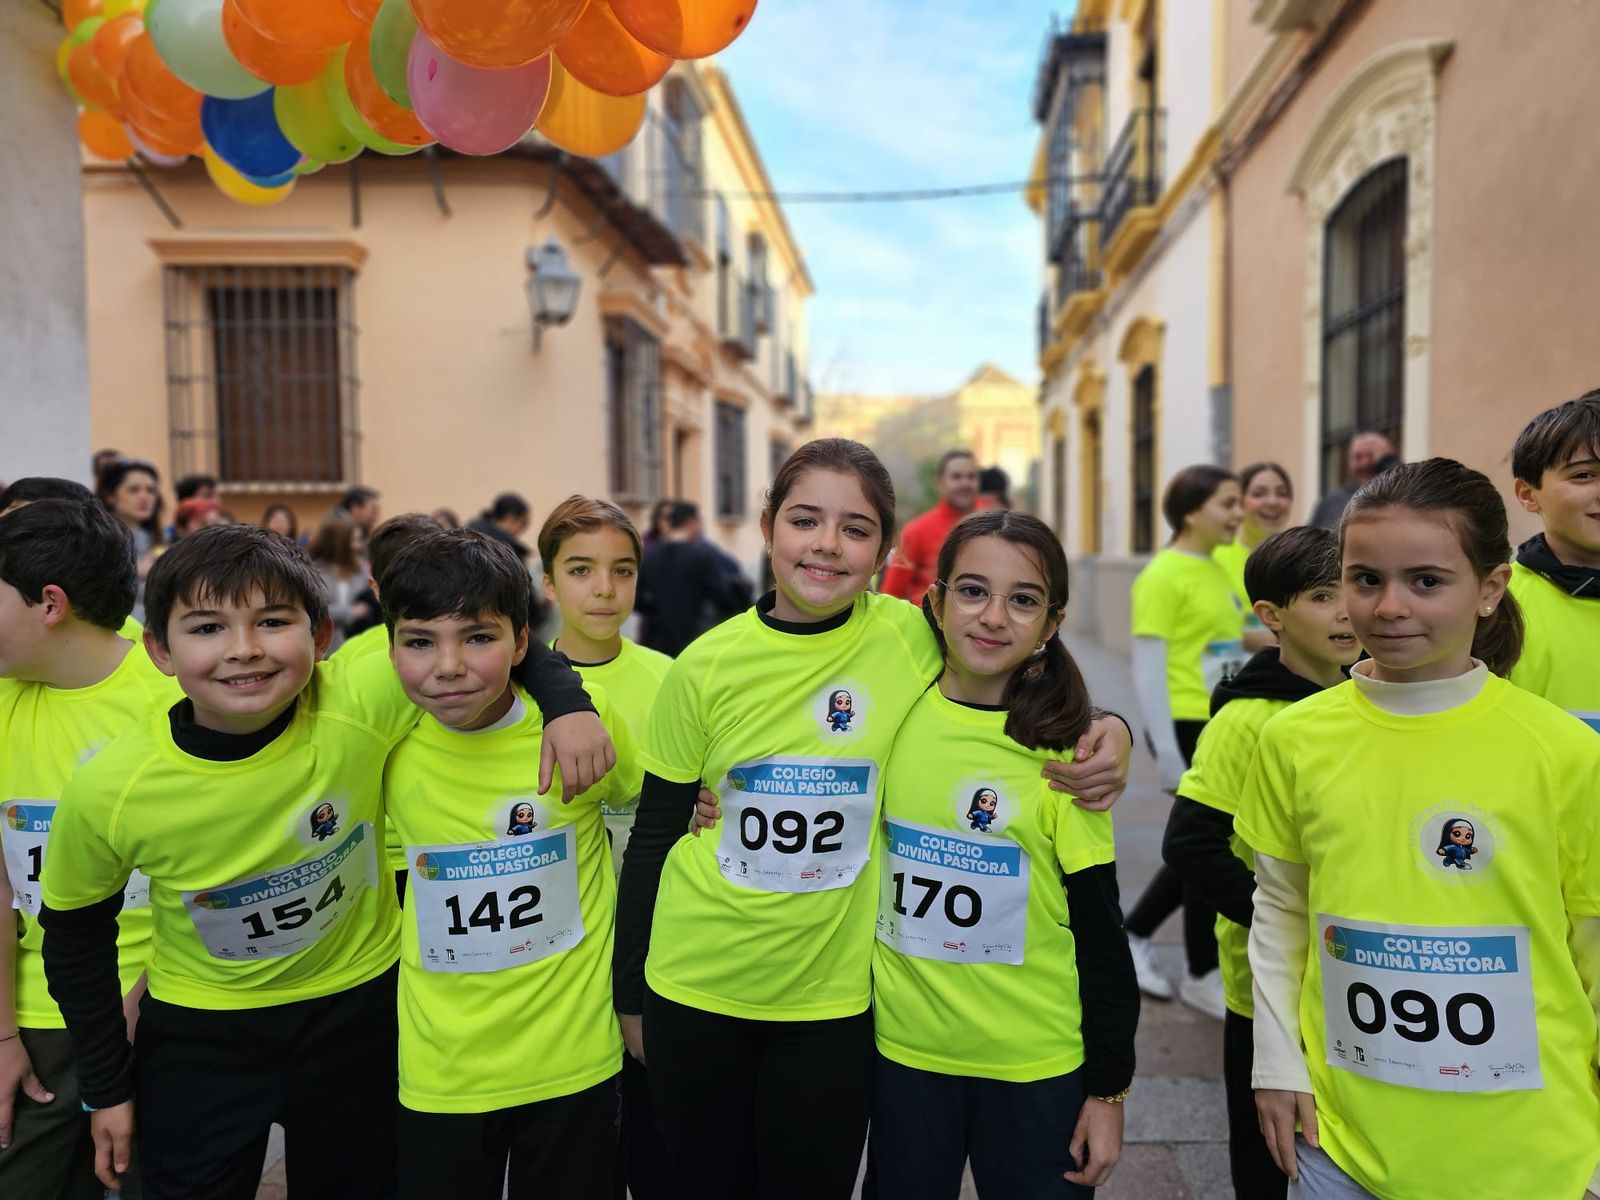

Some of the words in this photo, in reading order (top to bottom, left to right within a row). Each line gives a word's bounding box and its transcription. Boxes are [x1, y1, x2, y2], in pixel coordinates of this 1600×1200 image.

[754, 779, 796, 794] DIVINA
[798, 780, 859, 794] PASTORA
[772, 767, 836, 780] COLEGIO
[740, 807, 844, 854] 092
[919, 835, 983, 859] COLEGIO
[267, 852, 338, 887] COLEGIO
[445, 864, 494, 880] DIVINA
[495, 850, 559, 875] PASTORA
[469, 844, 534, 864] COLEGIO
[897, 842, 941, 864] DIVINA
[943, 852, 1010, 875] PASTORA
[240, 882, 299, 905] DIVINA
[300, 841, 359, 887] PASTORA
[241, 875, 346, 940] 154
[445, 885, 543, 935] 142
[892, 872, 983, 928] 170
[1355, 949, 1413, 970] DIVINA
[1417, 956, 1507, 973] PASTORA
[1383, 937, 1471, 956] COLEGIO
[1346, 981, 1496, 1046] 090
